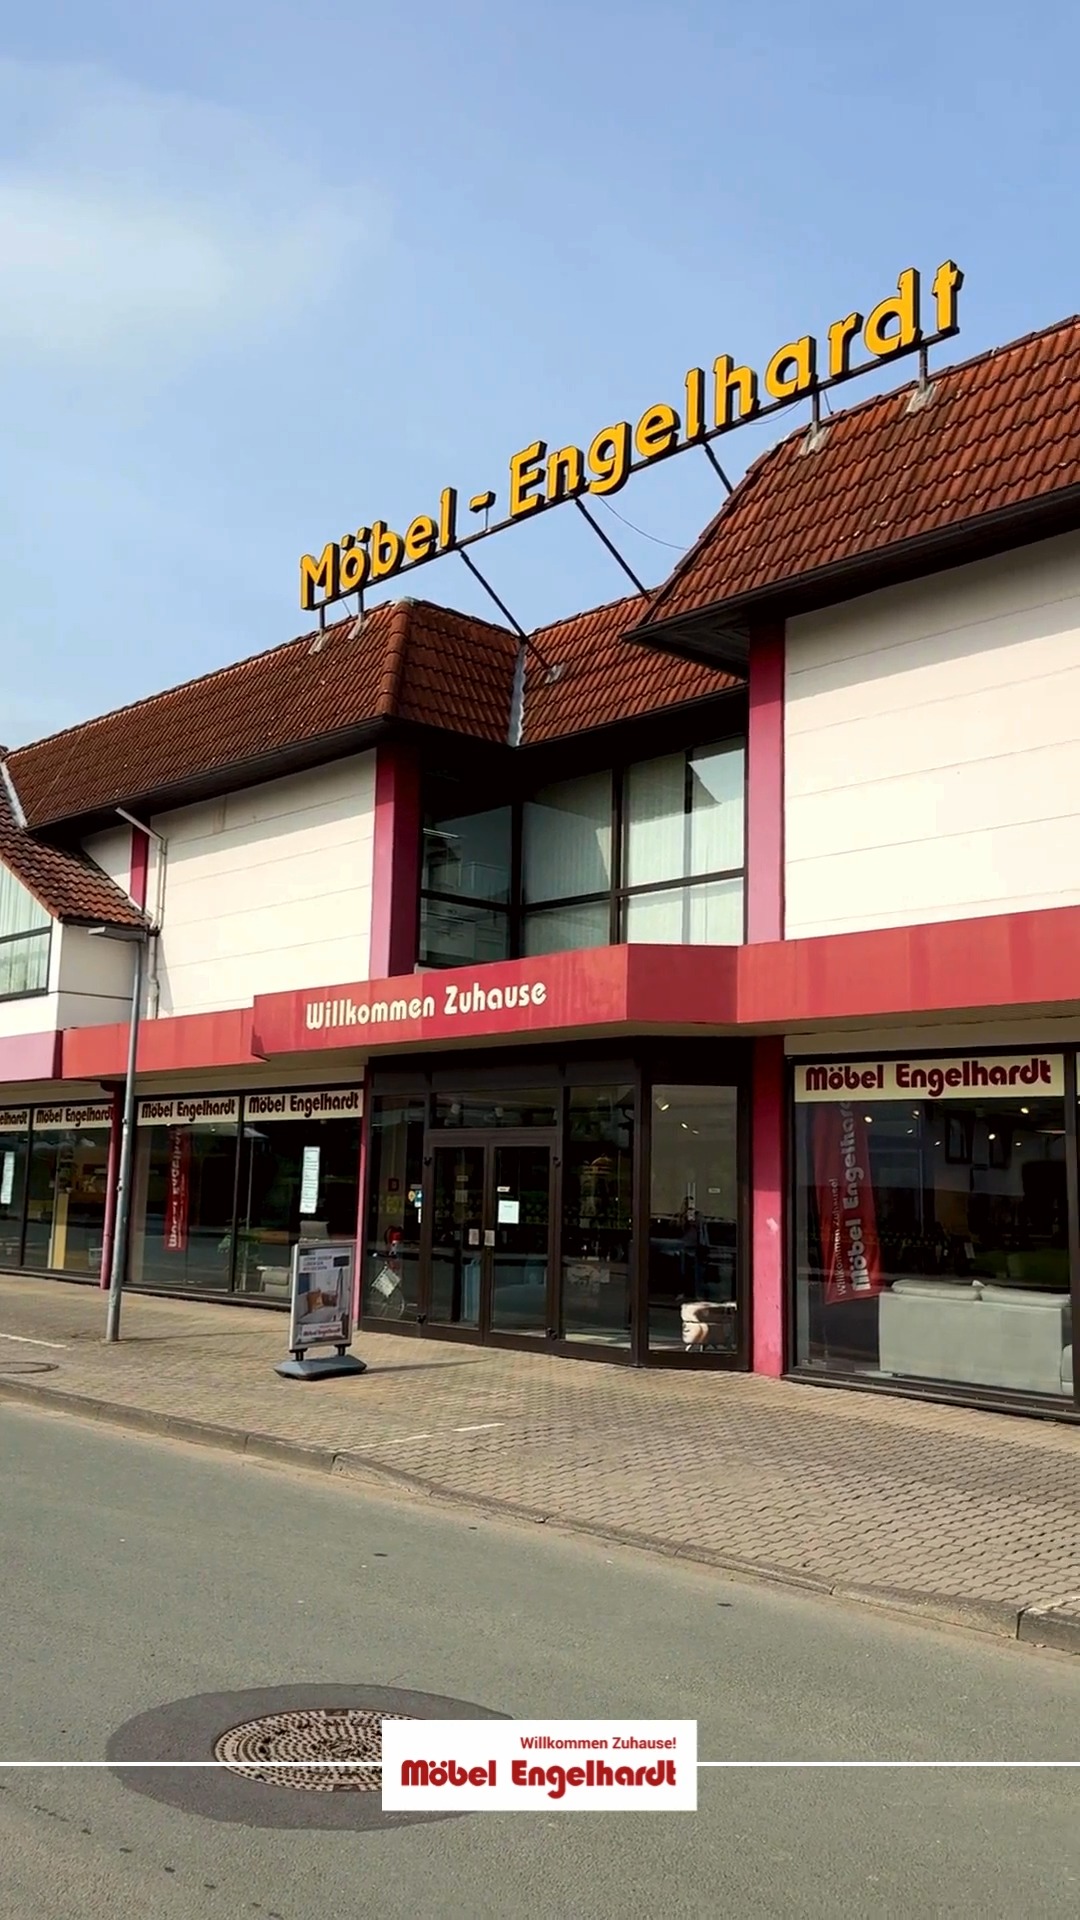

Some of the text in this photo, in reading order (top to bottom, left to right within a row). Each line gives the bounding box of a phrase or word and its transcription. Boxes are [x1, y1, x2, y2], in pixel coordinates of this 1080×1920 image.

[300, 487, 458, 609] Möbel
[509, 260, 964, 515] Engelhardt
[306, 981, 547, 1030] Willkommen Zuhause
[805, 1058, 1051, 1097] Möbel Engelhardt
[37, 1109, 63, 1123] Möbel
[142, 1100, 235, 1122] Möbel Engelhardt
[248, 1092, 358, 1118] Möbel Engelhardt
[841, 1101, 872, 1292] Möbel Engelhar
